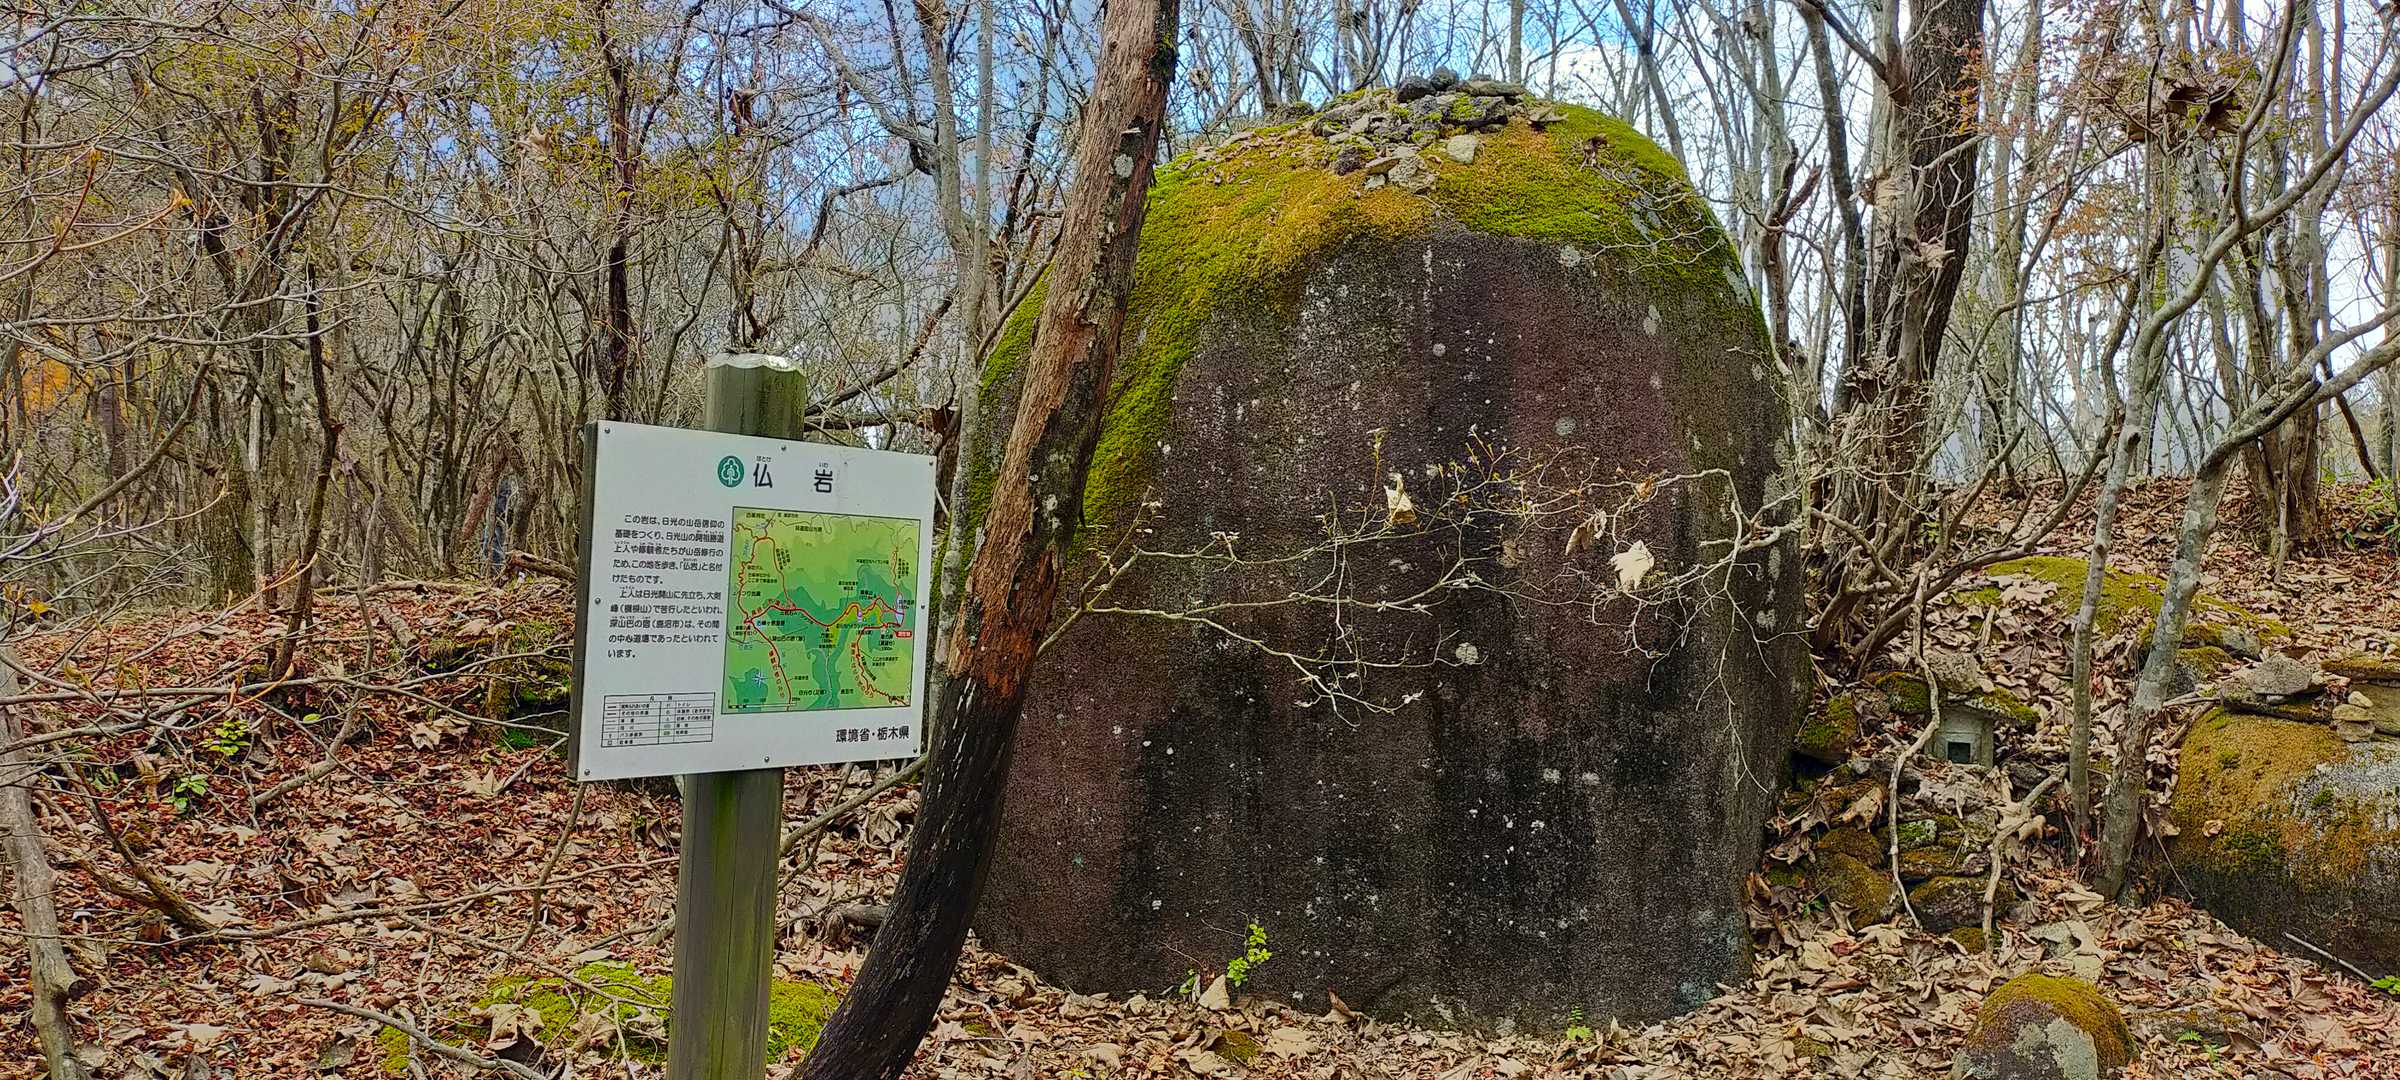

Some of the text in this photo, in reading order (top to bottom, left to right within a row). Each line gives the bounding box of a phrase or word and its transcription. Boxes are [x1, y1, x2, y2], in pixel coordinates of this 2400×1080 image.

[753, 463, 833, 493] 仏 岩
[612, 575, 664, 584] けたものです。
[607, 649, 636, 658] います。
[836, 725, 910, 743] 環境省・栃木県
